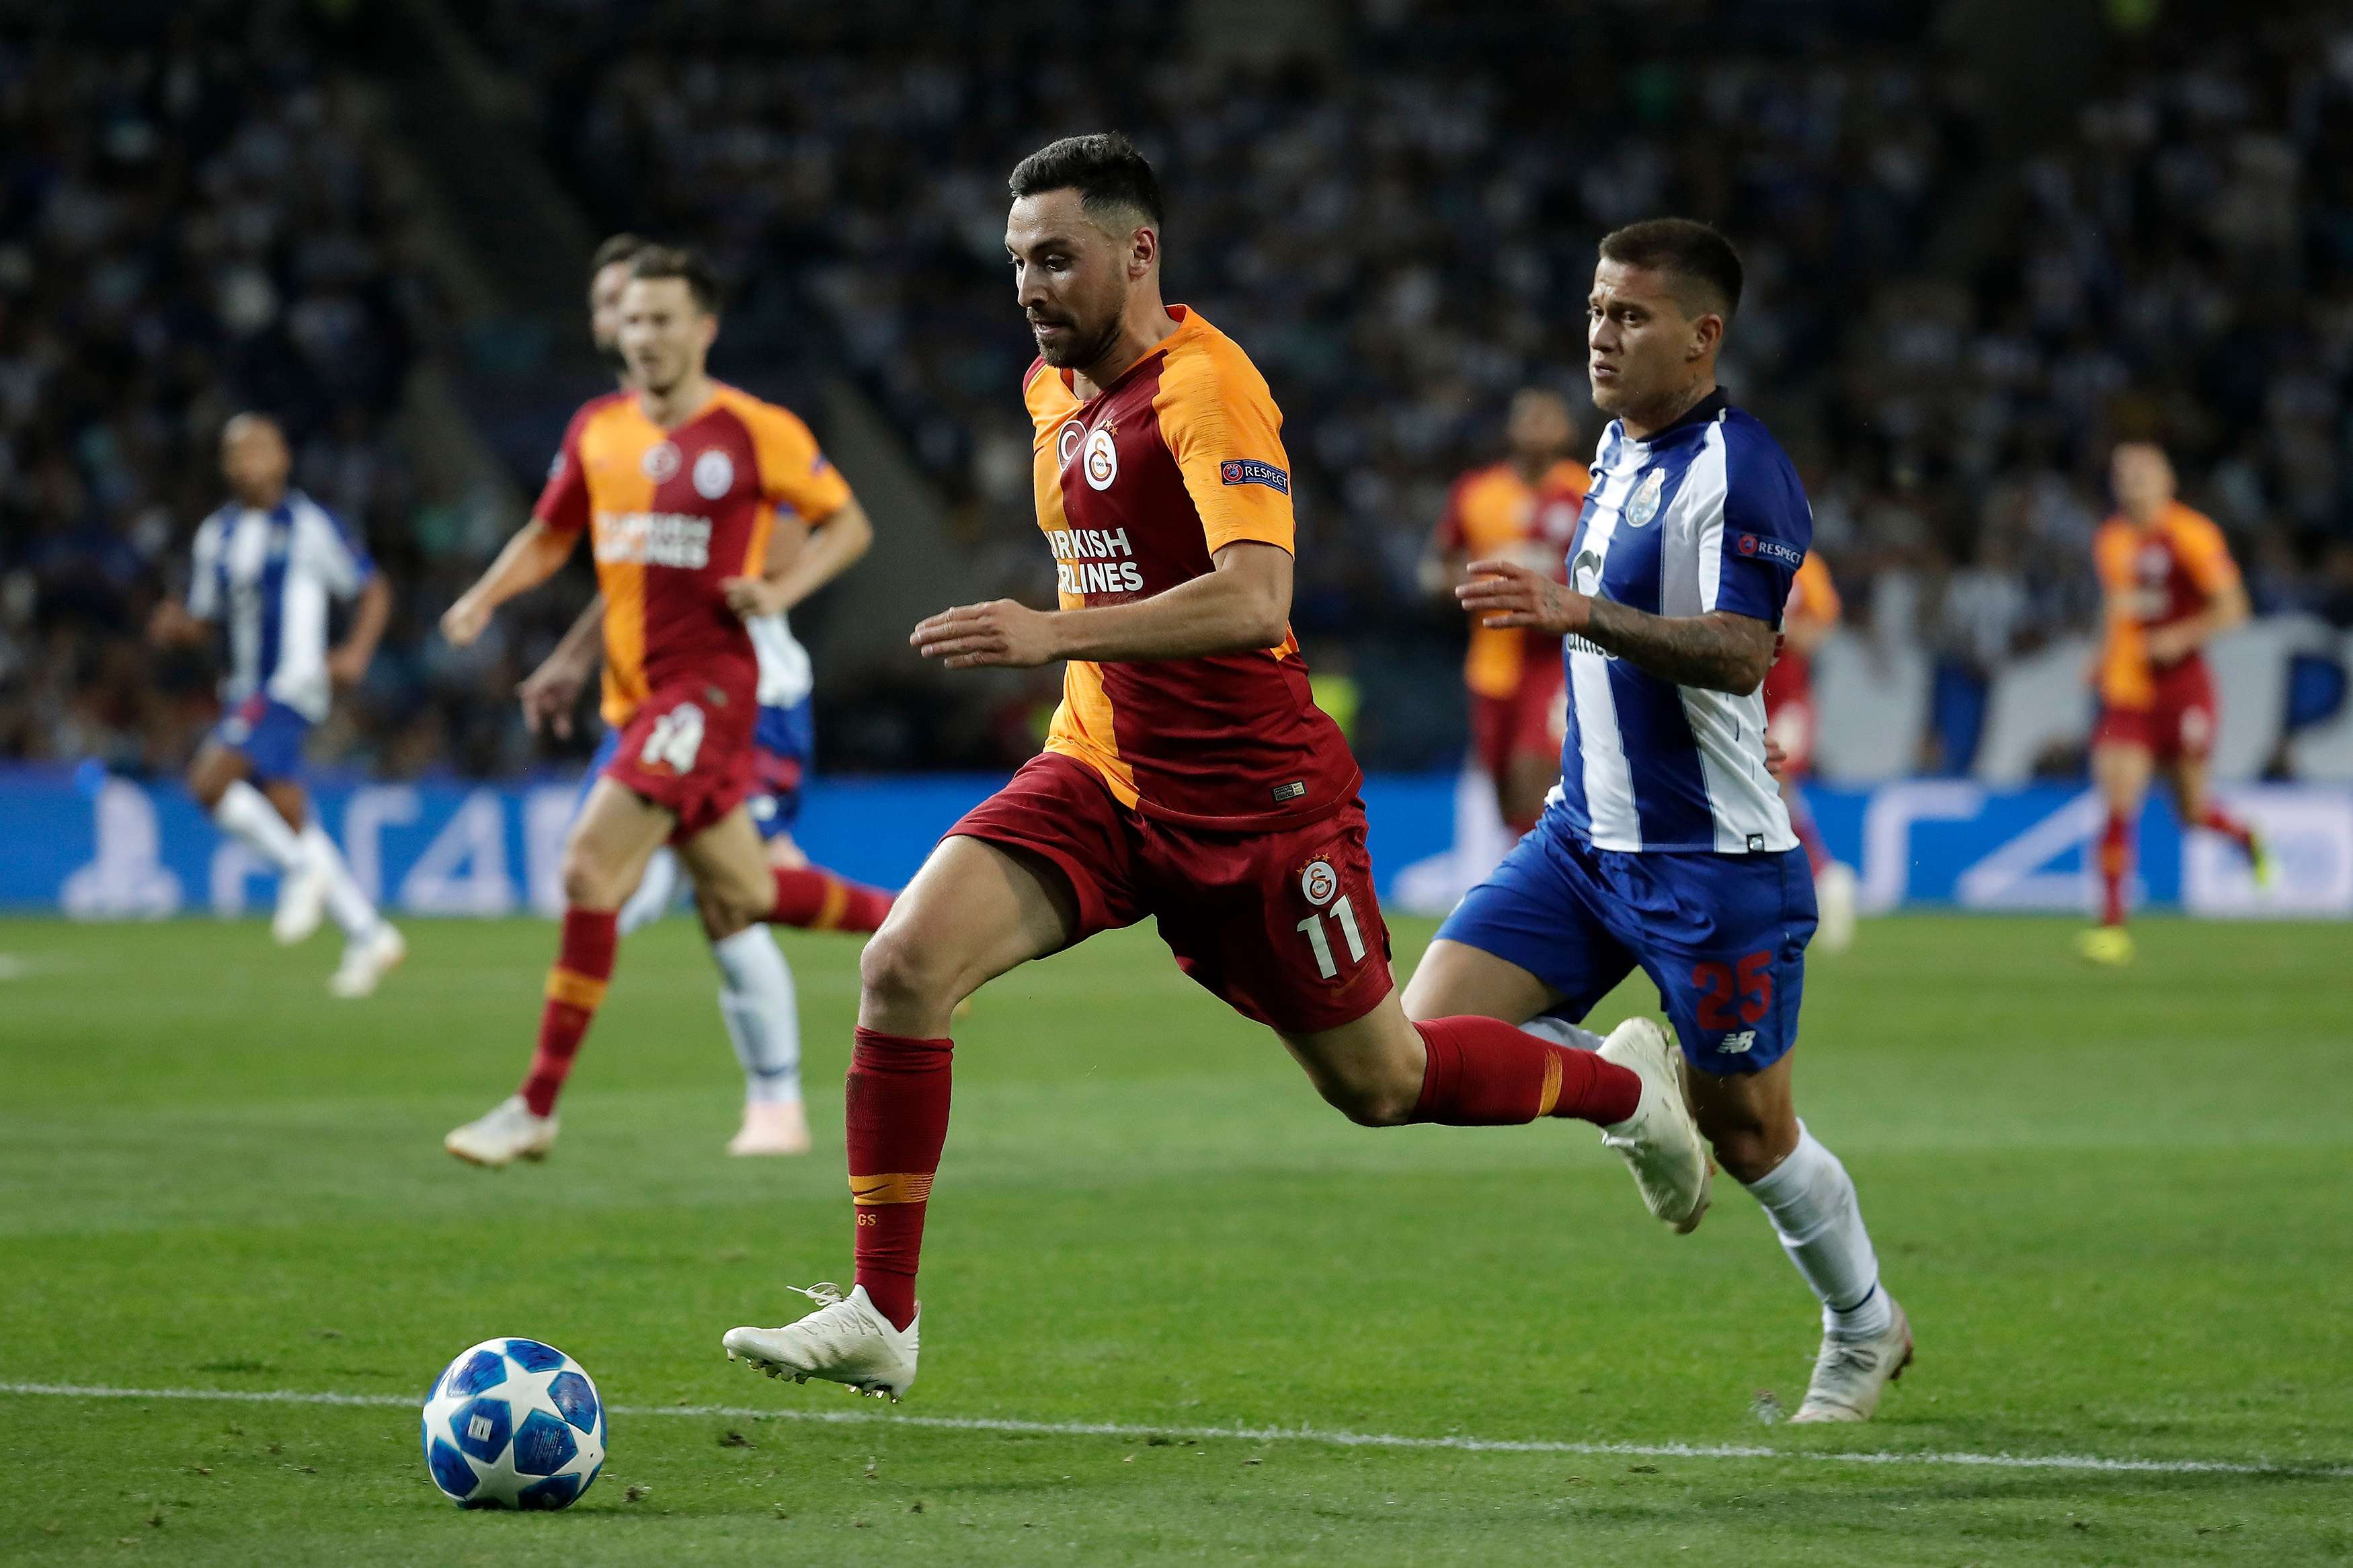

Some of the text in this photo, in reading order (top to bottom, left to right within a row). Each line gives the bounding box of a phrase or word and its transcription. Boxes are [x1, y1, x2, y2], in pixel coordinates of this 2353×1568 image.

[1244, 466, 1287, 488] RESPECT
[1043, 527, 1132, 559] URKISH
[1759, 541, 1802, 564] RESPECT
[1297, 894, 1366, 979] 11
[1691, 950, 1773, 1030] 25
[857, 1213, 876, 1226] GS
